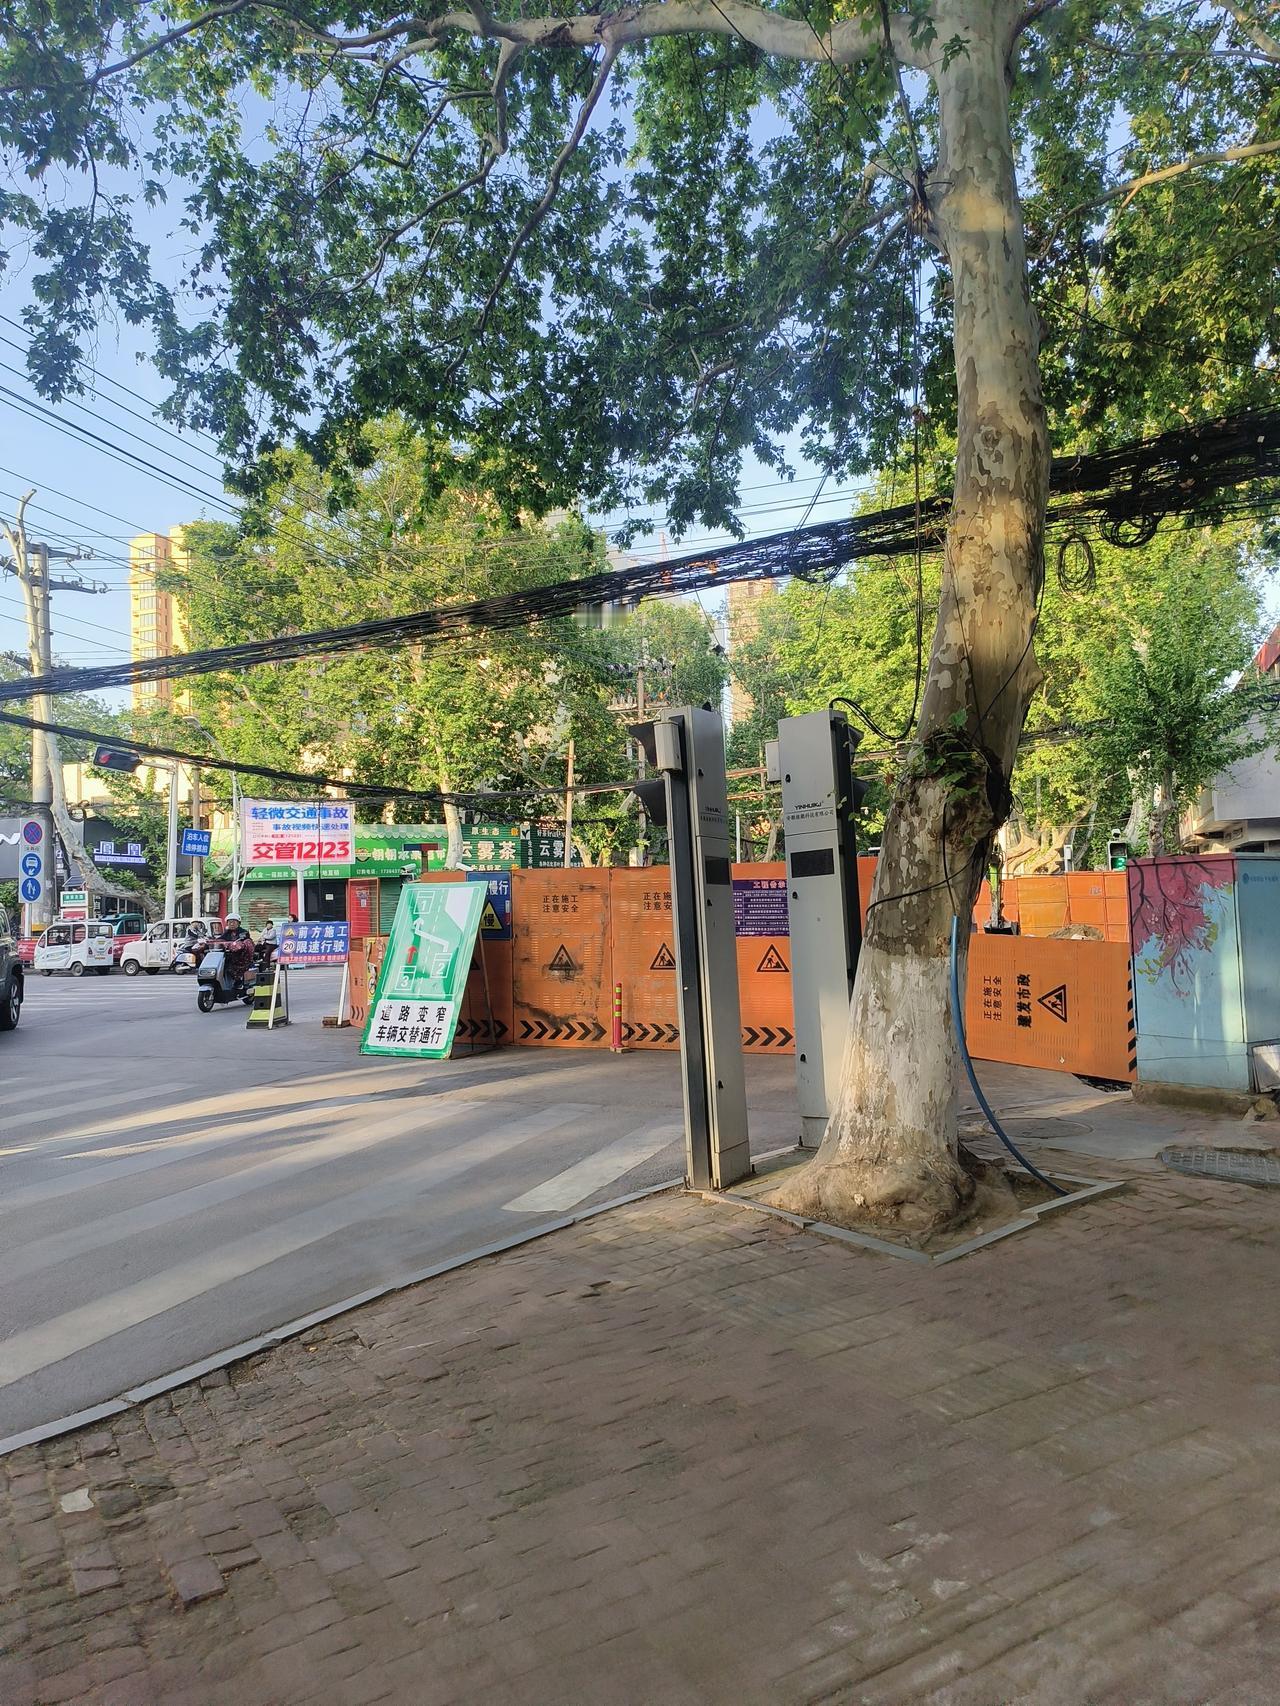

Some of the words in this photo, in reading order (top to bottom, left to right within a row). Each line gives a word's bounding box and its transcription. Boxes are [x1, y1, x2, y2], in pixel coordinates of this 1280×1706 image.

[251, 806, 349, 820] 轻微交通事故
[272, 823, 350, 832] 事故视频快速处理
[471, 827, 500, 836] 原生态
[252, 841, 350, 860] 交管12123
[486, 880, 508, 896] 慢行
[542, 895, 578, 903] 正在施工
[642, 892, 673, 901] 正在施
[542, 904, 579, 913] 注意安全
[643, 901, 673, 911] 注意安
[484, 913, 495, 927] 慢
[298, 926, 348, 938] 前方施工
[284, 943, 294, 951] 20
[296, 939, 345, 954] 限速行驶
[983, 976, 994, 1020] 正在施工
[992, 976, 1002, 1021] 注意安全
[1016, 973, 1032, 1029] 建发市政
[380, 1005, 447, 1023] 道路变窄
[376, 1025, 443, 1044] 车辆交替通行
